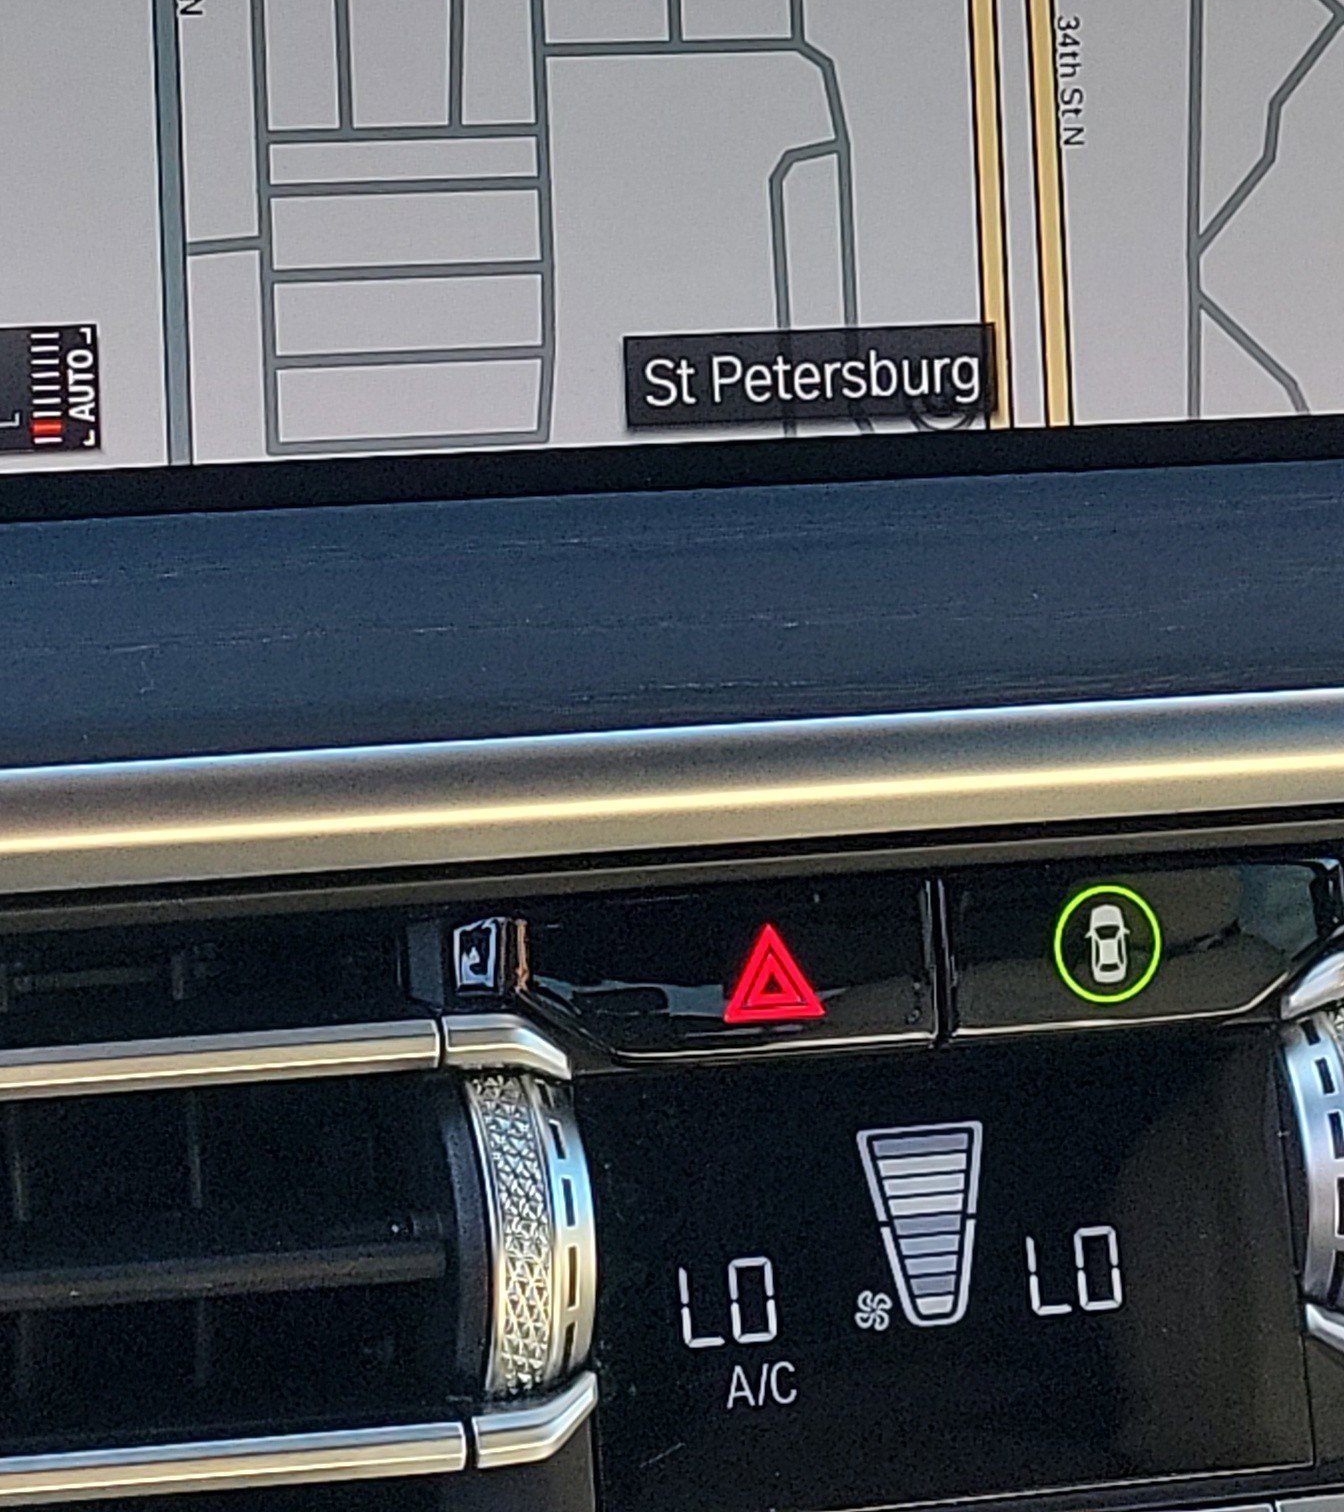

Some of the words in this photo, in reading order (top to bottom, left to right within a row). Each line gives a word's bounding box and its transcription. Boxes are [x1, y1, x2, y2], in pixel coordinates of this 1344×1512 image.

[1056, 15, 1082, 78] 34th
[1060, 88, 1083, 119] St
[1063, 126, 1085, 146] N
[67, 347, 96, 423] AUTO
[645, 357, 696, 406] St
[710, 349, 981, 404] Petersburg
[726, 1360, 798, 1409] A/C
